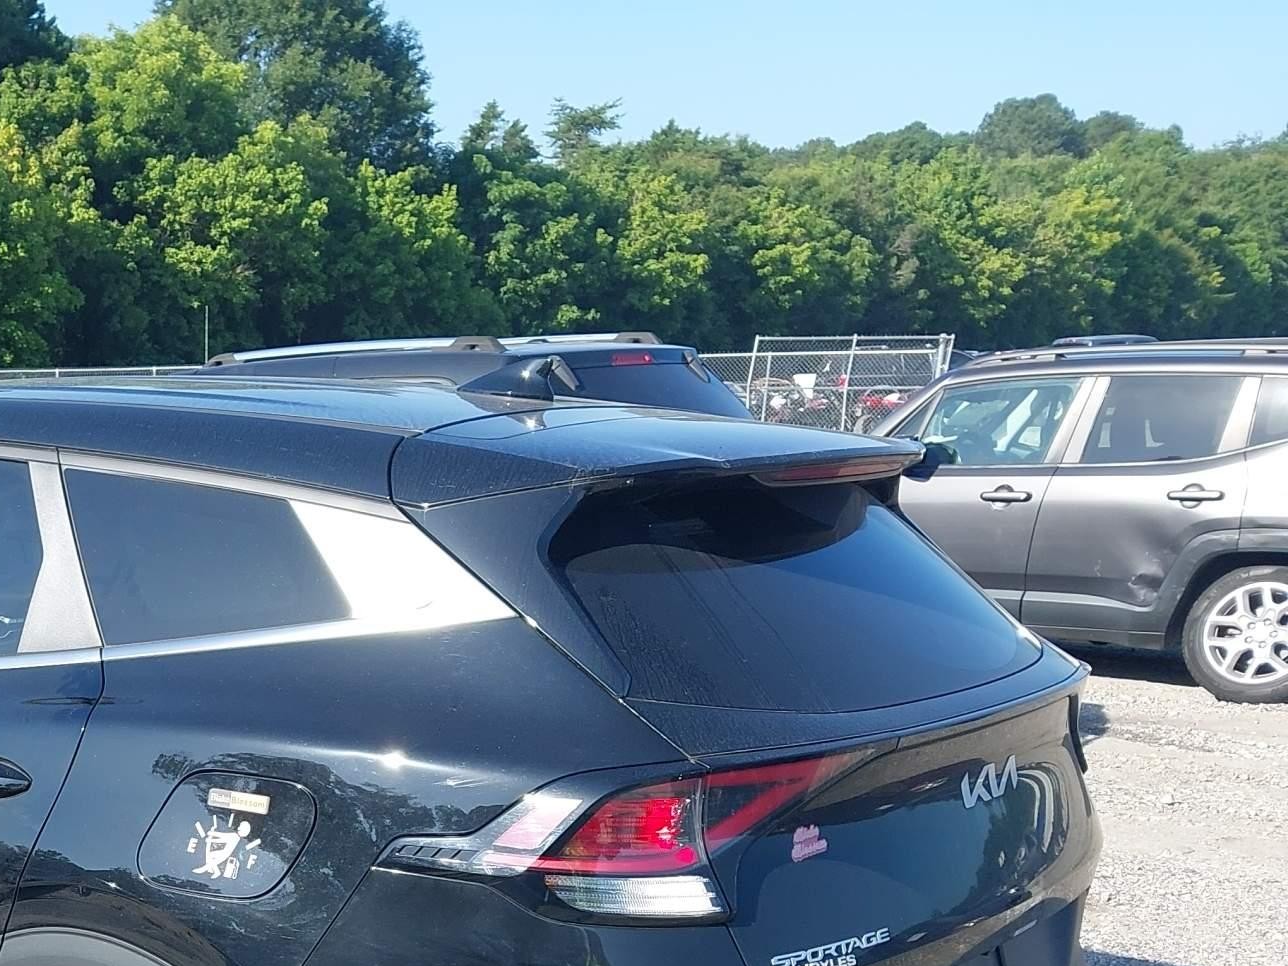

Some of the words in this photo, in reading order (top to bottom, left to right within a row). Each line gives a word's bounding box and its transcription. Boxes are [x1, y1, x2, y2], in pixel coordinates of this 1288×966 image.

[961, 754, 1018, 809] KIA
[186, 837, 199, 854] E
[246, 853, 258, 870] F
